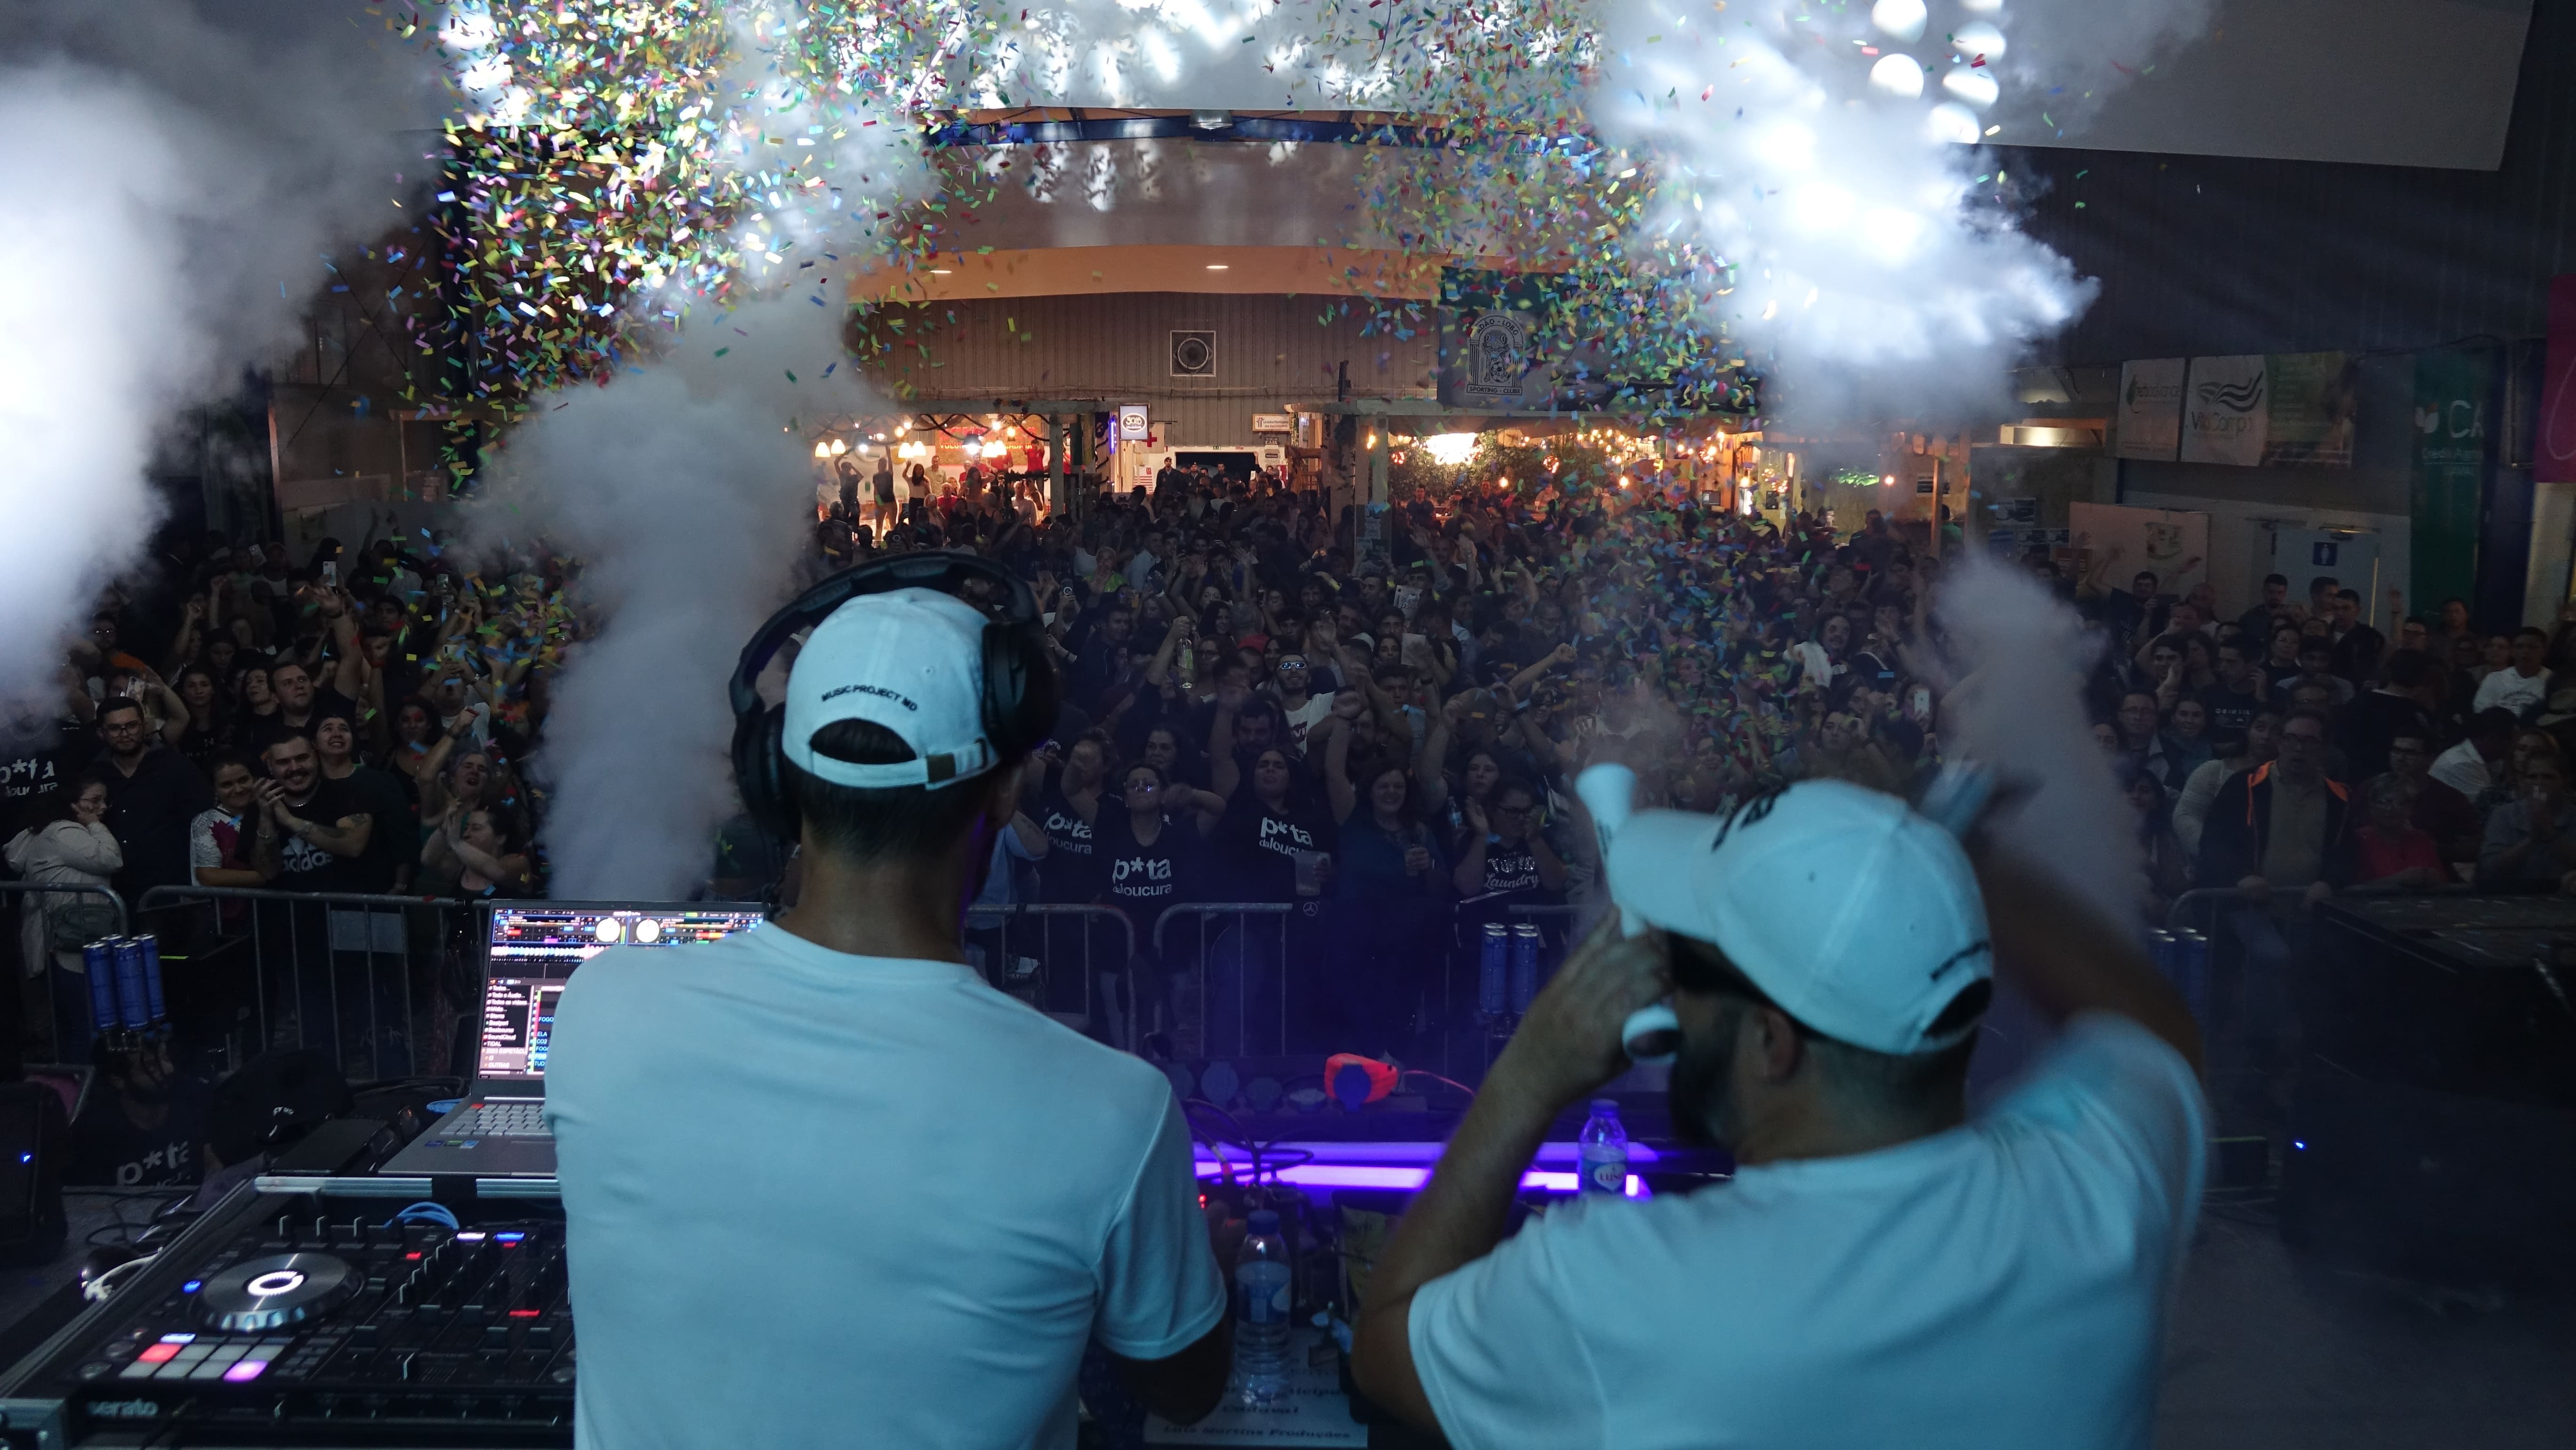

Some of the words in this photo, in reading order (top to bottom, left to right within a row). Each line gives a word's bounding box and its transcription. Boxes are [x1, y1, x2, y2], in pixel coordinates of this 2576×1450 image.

[1502, 319, 1519, 336] LOBO
[821, 685, 851, 701] MUSIC
[852, 685, 902, 701] PROJECT
[901, 697, 918, 711] MD
[1484, 872, 1538, 890] Laundry
